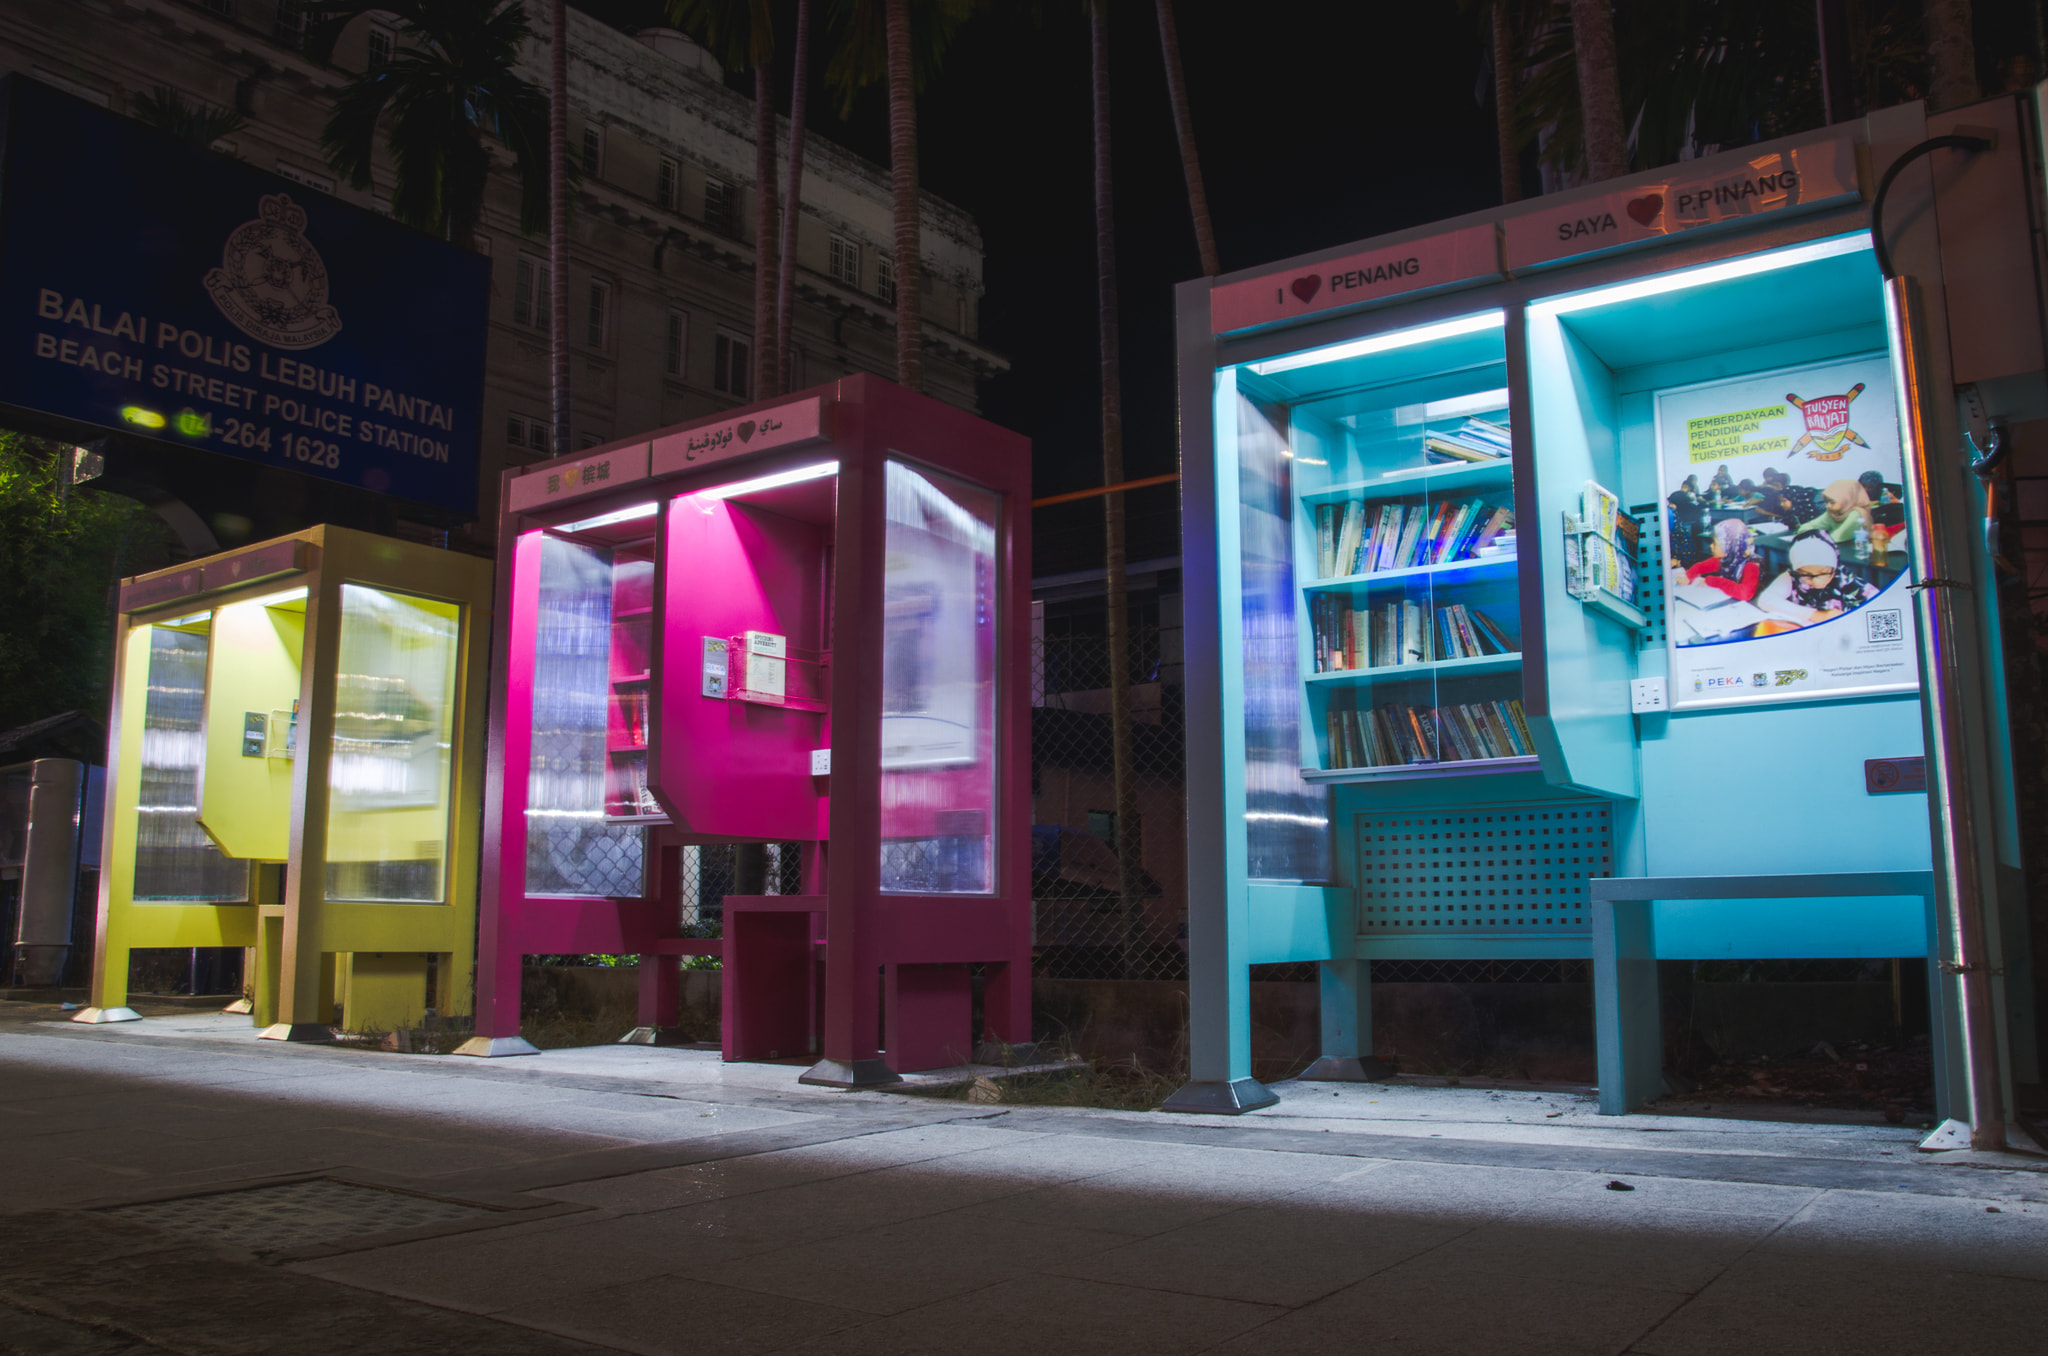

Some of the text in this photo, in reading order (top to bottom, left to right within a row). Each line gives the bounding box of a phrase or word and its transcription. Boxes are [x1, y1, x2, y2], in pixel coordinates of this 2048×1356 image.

[1559, 170, 1796, 241] SAYA P.PINANG
[1278, 257, 1420, 304] I PENANG
[219, 295, 328, 344] POLIS DIRAJA MALAYSIA
[38, 287, 453, 431] BALAI POLIS LEBUH PANTAI
[36, 332, 449, 464] BEACH STREET POLICE STATION
[1805, 399, 1846, 415] TUISYEN
[1690, 407, 1784, 430] PEMBERDAYAAN
[1807, 411, 1847, 429] RAKYAT
[1691, 421, 1760, 440] PENDIDIKAN
[281, 432, 340, 469] 1628
[1692, 435, 1740, 451] MELALUI
[1692, 438, 1788, 461] TUISYEN RAKYAT
[1708, 676, 1744, 687] PEKA
